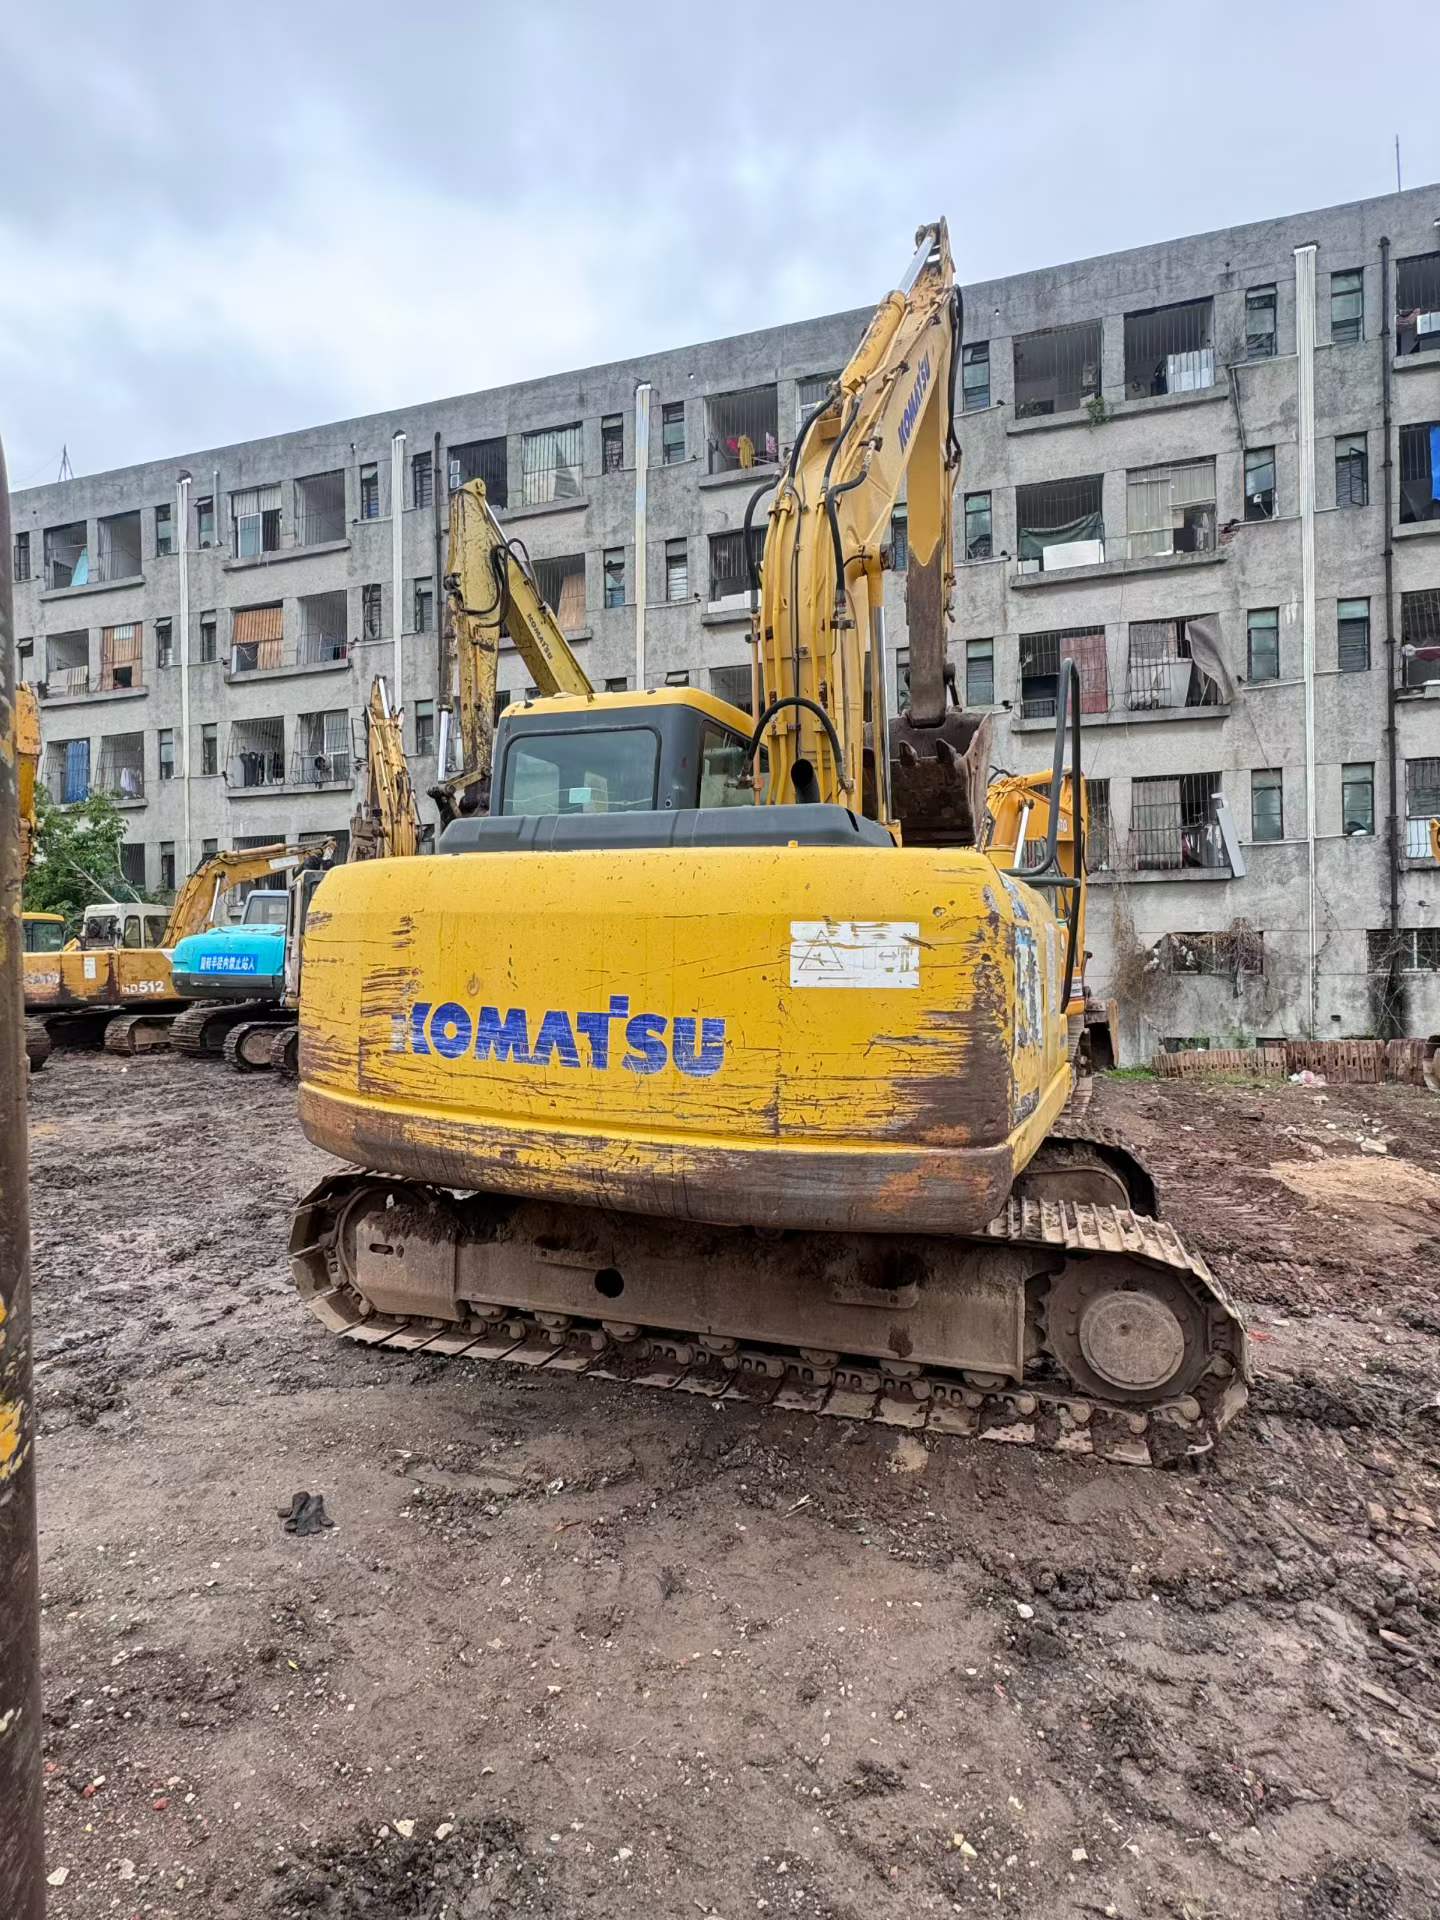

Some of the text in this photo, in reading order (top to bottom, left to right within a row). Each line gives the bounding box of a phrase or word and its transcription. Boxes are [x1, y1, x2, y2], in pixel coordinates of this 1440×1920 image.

[898, 350, 930, 455] KOMATSU
[527, 613, 553, 660] KOMATSU
[391, 995, 726, 1078] KOMATSU
